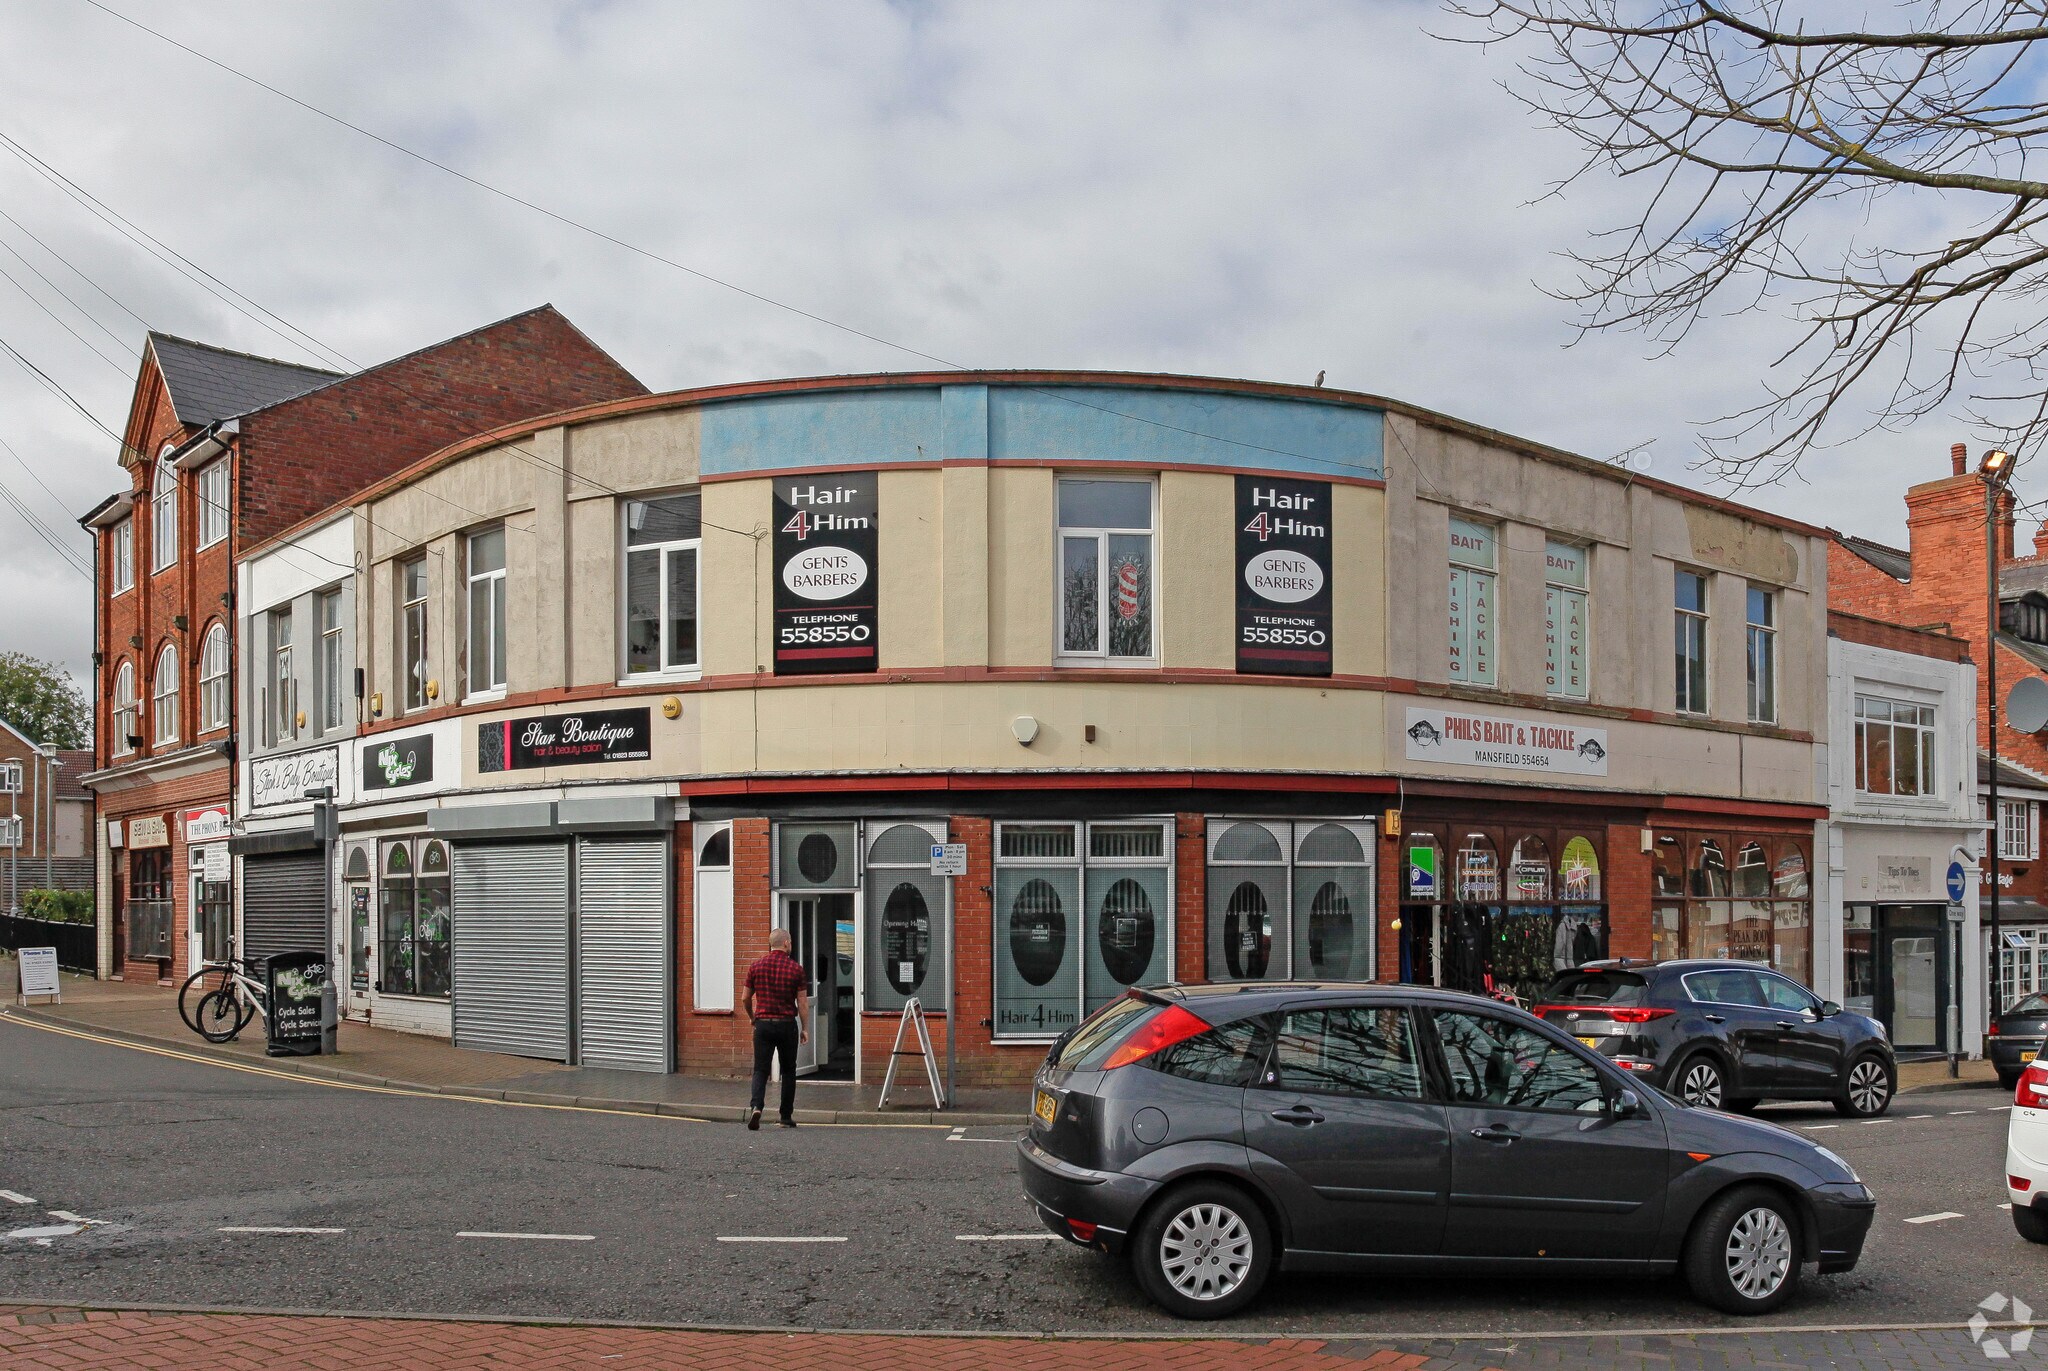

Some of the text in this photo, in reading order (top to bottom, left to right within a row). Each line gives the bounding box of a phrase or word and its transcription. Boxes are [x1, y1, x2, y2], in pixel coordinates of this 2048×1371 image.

[791, 486, 858, 506] Hair
[1253, 487, 1315, 510] Hair
[781, 510, 868, 541] 4 Him
[1244, 512, 1324, 542] 4 Him
[1451, 533, 1483, 551] BAIT
[802, 556, 848, 570] GENTS
[1263, 559, 1306, 574] GENTS
[1546, 555, 1576, 571] BAIT
[793, 573, 857, 587] BARBERS
[1255, 575, 1314, 590] BARBERS
[792, 614, 859, 624] TELEPHONE
[1253, 616, 1315, 627] TELEPHONE
[1450, 572, 1460, 673] FISHING
[1477, 581, 1486, 673] TACKLE
[781, 625, 870, 644] 558550
[1243, 627, 1326, 646] 558550
[1546, 592, 1555, 685] FISHING
[1570, 600, 1579, 686] TACKLE
[521, 718, 634, 749] Star Boutique
[1444, 716, 1575, 751] PHILS BAIT & TACKLE
[378, 747, 398, 768] Nix
[534, 743, 602, 756] hair & beauty salon
[1475, 750, 1549, 767] MANSFIELD 554654
[302, 759, 334, 787] Boutique
[385, 762, 412, 785] Cycles
[191, 823, 201, 835] THE
[202, 821, 218, 834] PHONE
[1888, 866, 1920, 878] Tips To Toes
[1745, 915, 1758, 928] THE
[1733, 929, 1769, 943] PEAK BODY
[276, 970, 303, 987] Nix
[288, 983, 322, 1001] Cycles
[278, 1005, 316, 1019] Cycle Sales
[1001, 1004, 1074, 1029] Hair 4 Him
[280, 1020, 297, 1031] Cycle
